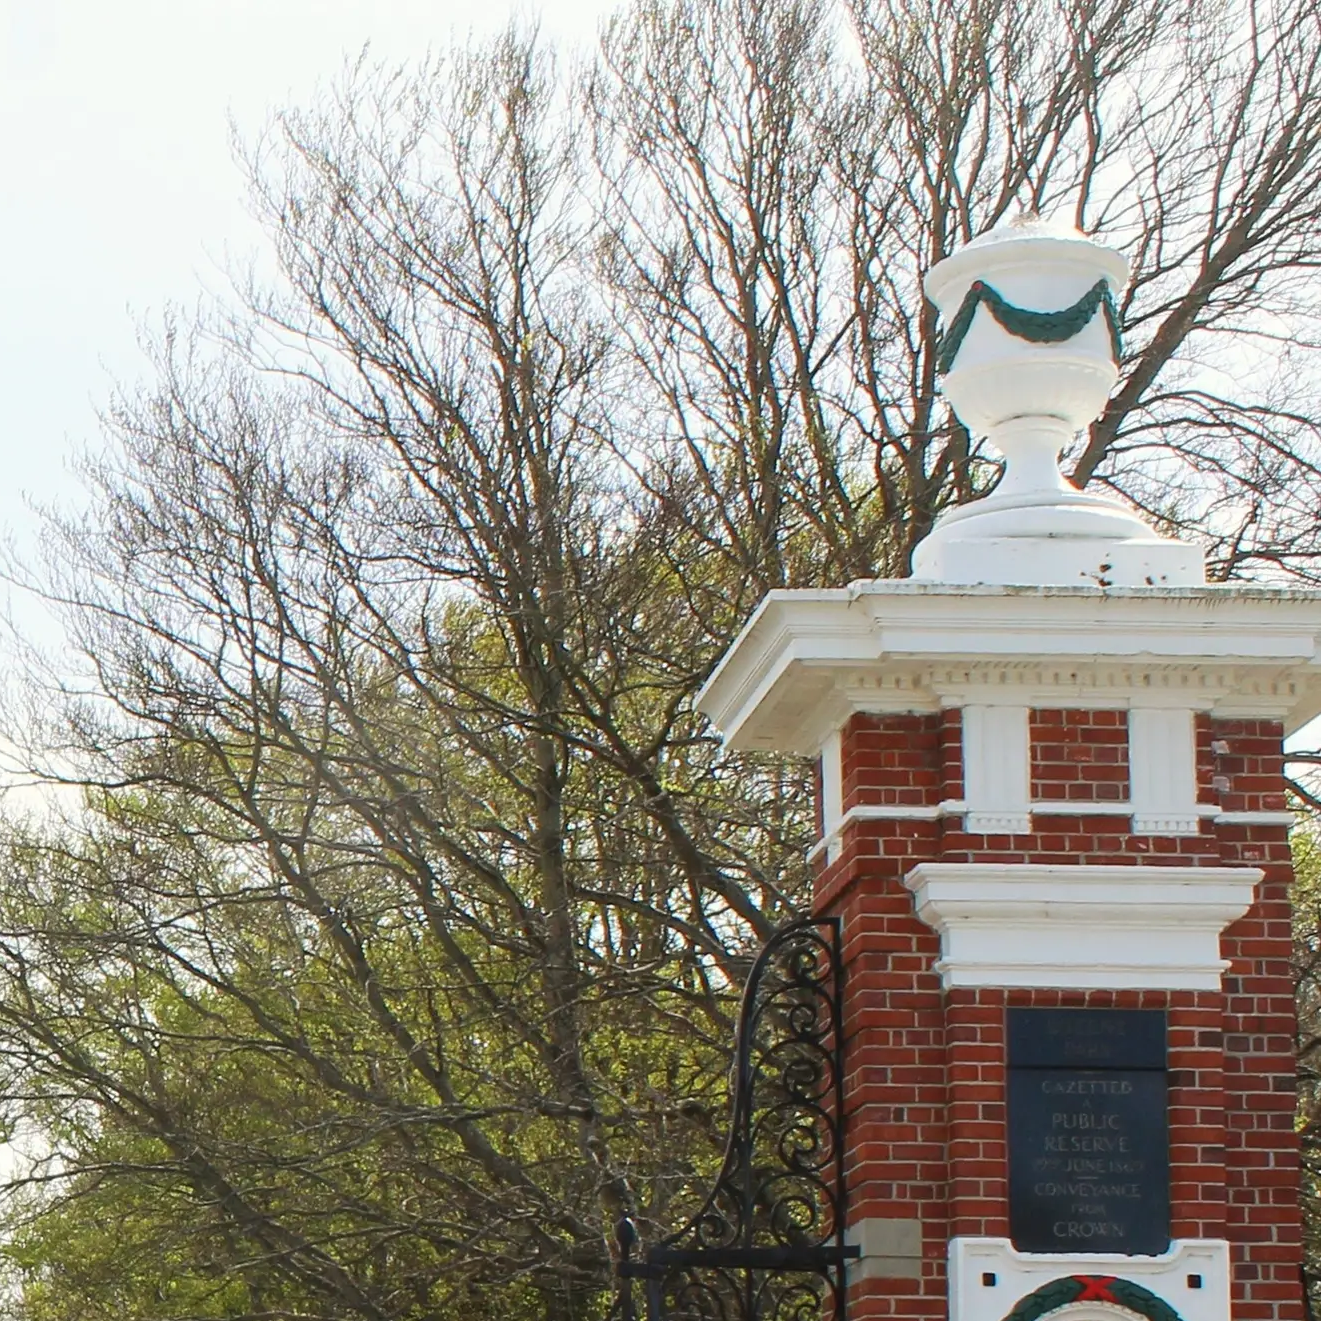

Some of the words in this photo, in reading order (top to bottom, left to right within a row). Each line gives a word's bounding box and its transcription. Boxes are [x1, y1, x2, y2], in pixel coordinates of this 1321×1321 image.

[1041, 1080, 1133, 1095] GAZETTED
[1052, 1112, 1121, 1130] PUBLIC
[1044, 1136, 1131, 1152] RESERVE
[1064, 1158, 1106, 1173] JUNE
[1034, 1182, 1142, 1199] CONVEYANCE
[1053, 1221, 1126, 1238] CROWN
